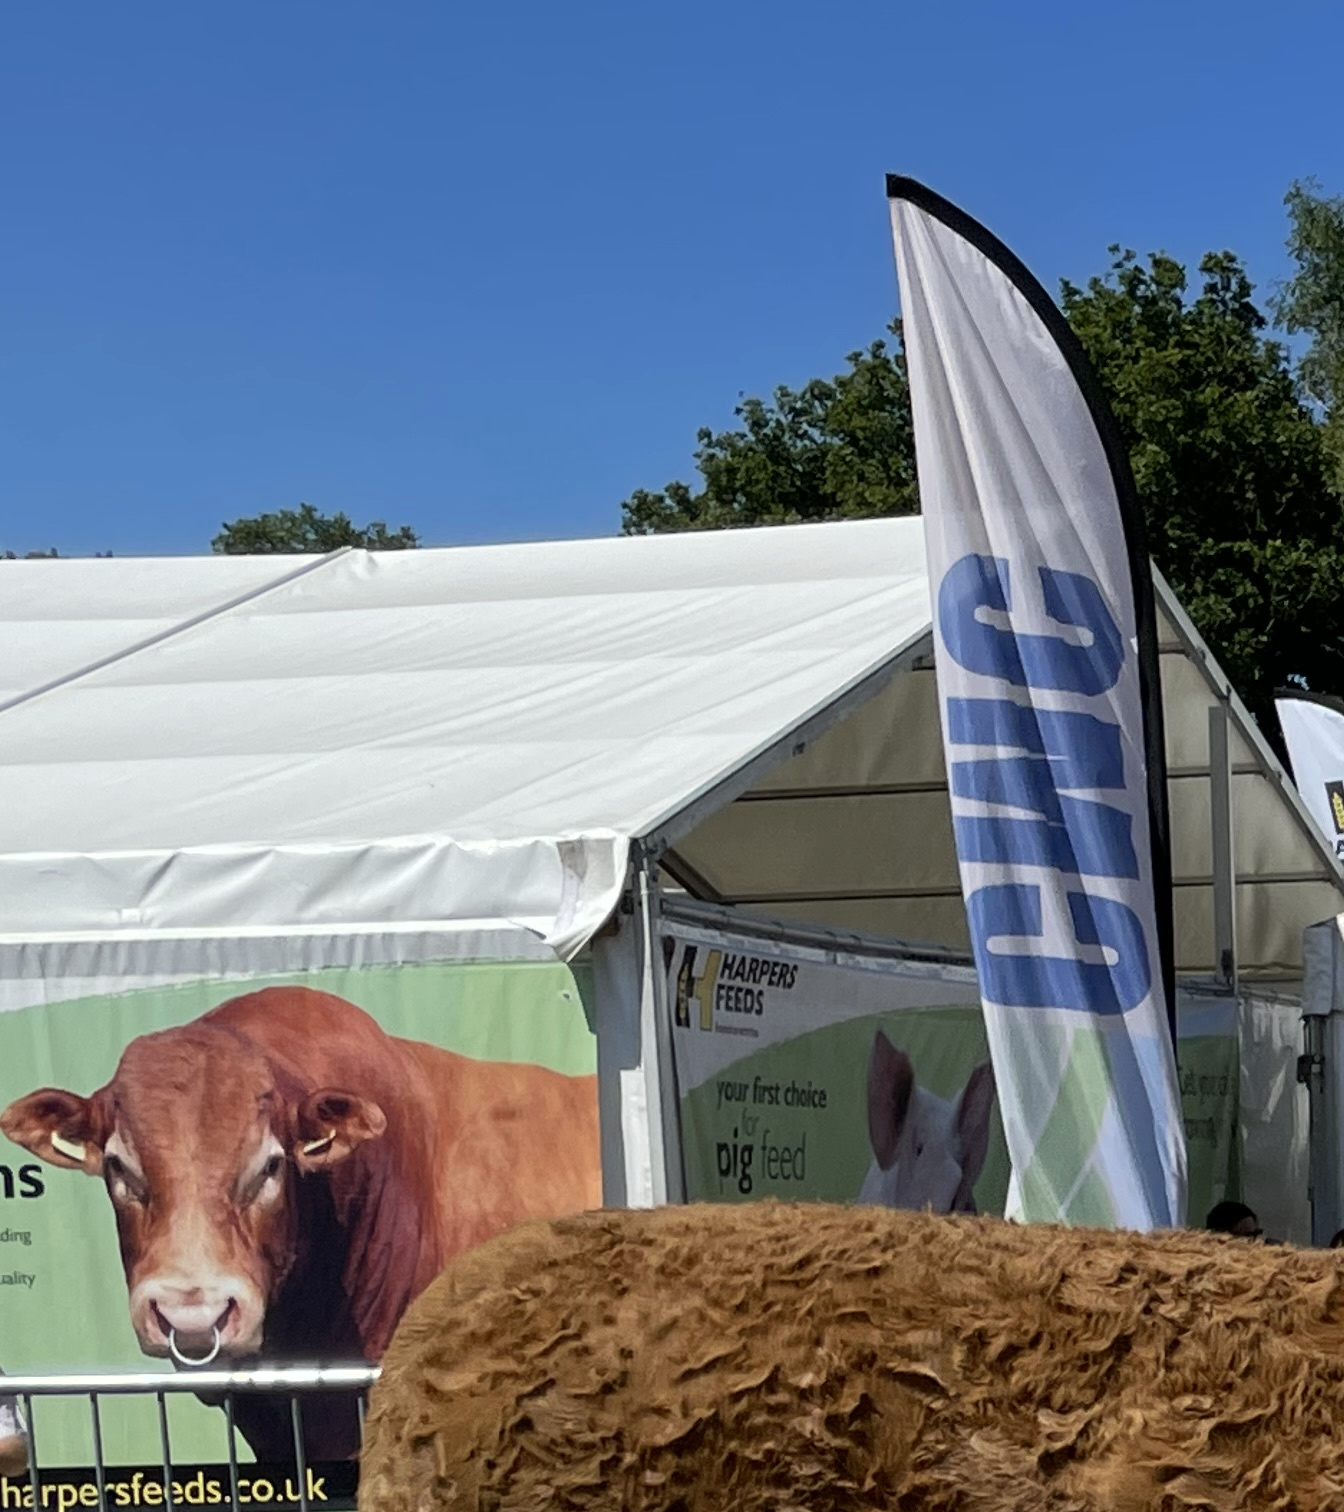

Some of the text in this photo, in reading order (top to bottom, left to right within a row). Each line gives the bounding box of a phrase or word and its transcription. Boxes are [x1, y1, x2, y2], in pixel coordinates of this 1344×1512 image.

[938, 551, 1152, 1016] CMC
[719, 952, 799, 990] HARPERS
[715, 983, 765, 1016] FEEDS
[716, 1075, 827, 1111] your first choice
[742, 1107, 759, 1136] for
[716, 1127, 806, 1195] pig feed
